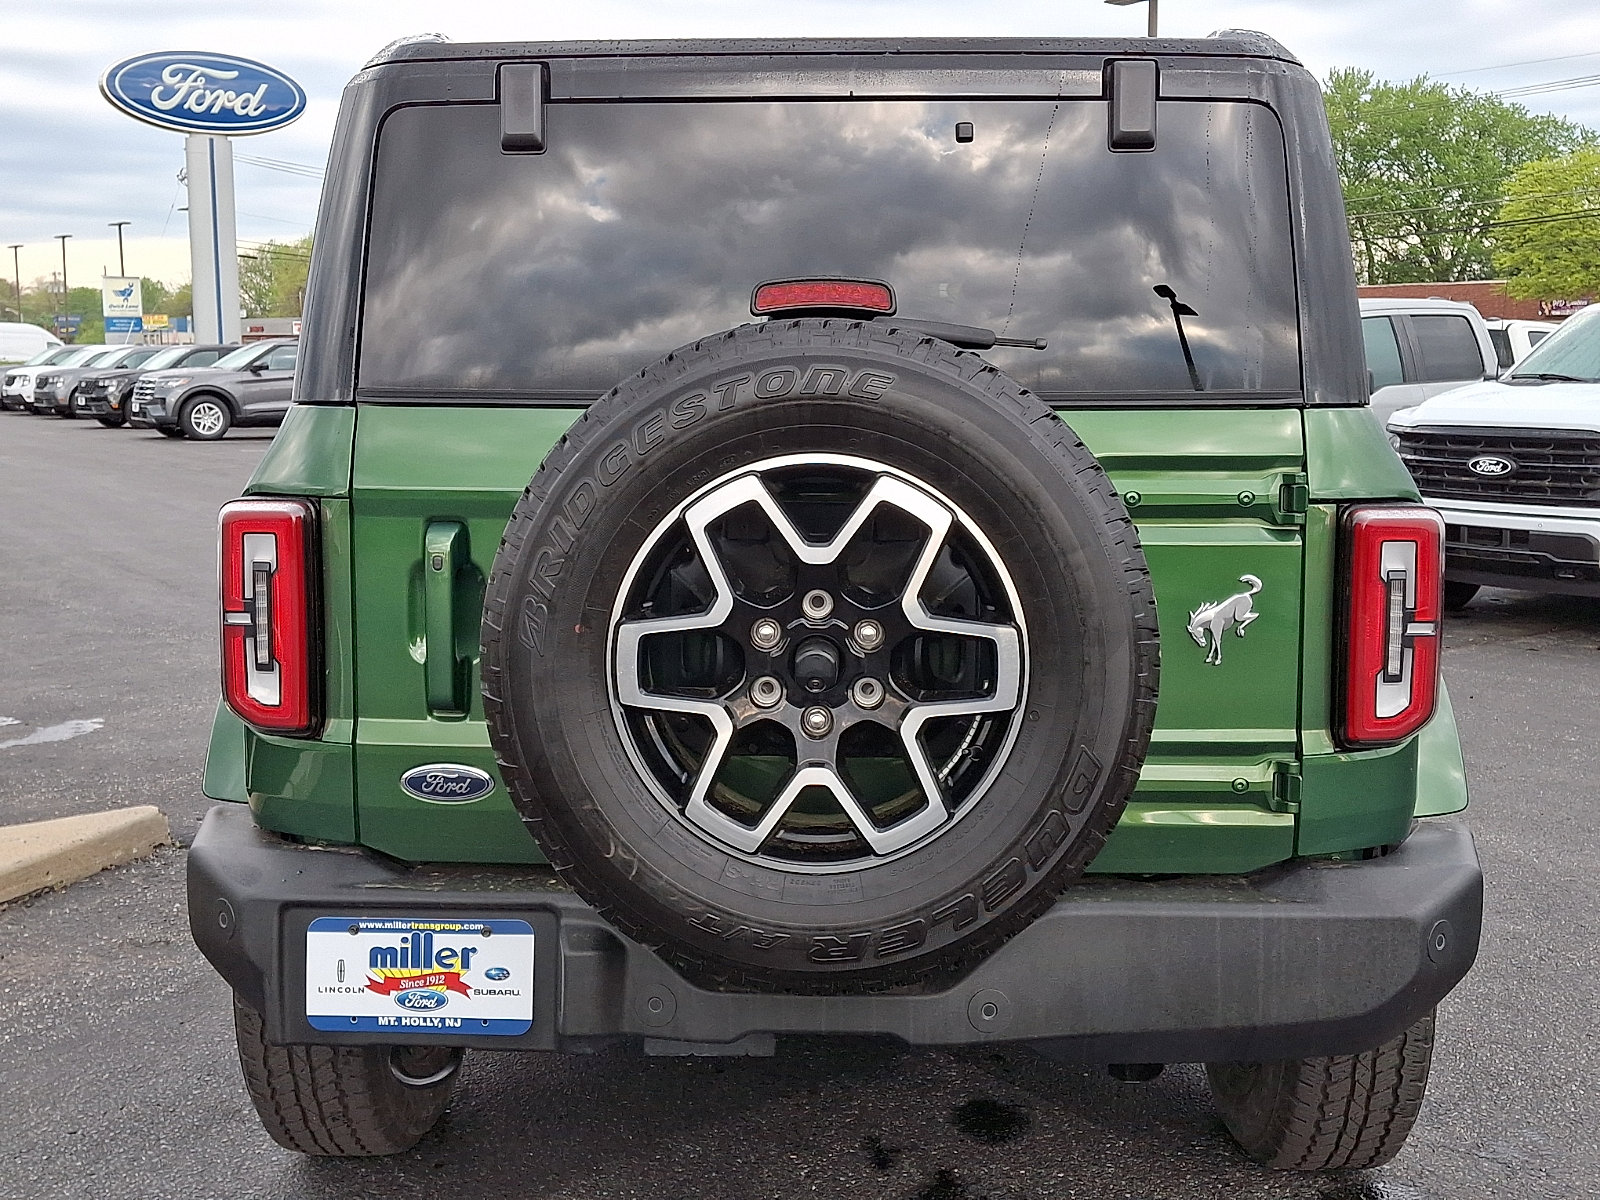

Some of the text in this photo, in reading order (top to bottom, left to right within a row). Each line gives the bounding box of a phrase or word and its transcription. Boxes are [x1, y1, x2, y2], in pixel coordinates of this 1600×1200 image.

[151, 64, 268, 117] Ford
[1476, 460, 1503, 473] Ford
[518, 364, 896, 657] BRIDGESTONE
[421, 772, 472, 794] Ford
[807, 744, 1104, 962] DUELER
[359, 921, 484, 931] www.millertransgroup.com
[369, 932, 477, 970] miller
[318, 986, 365, 994] LINCOLN
[400, 974, 445, 989] Since 1912
[404, 992, 438, 1009] Ford
[378, 1017, 462, 1028] MT. HOLLY, NJ
